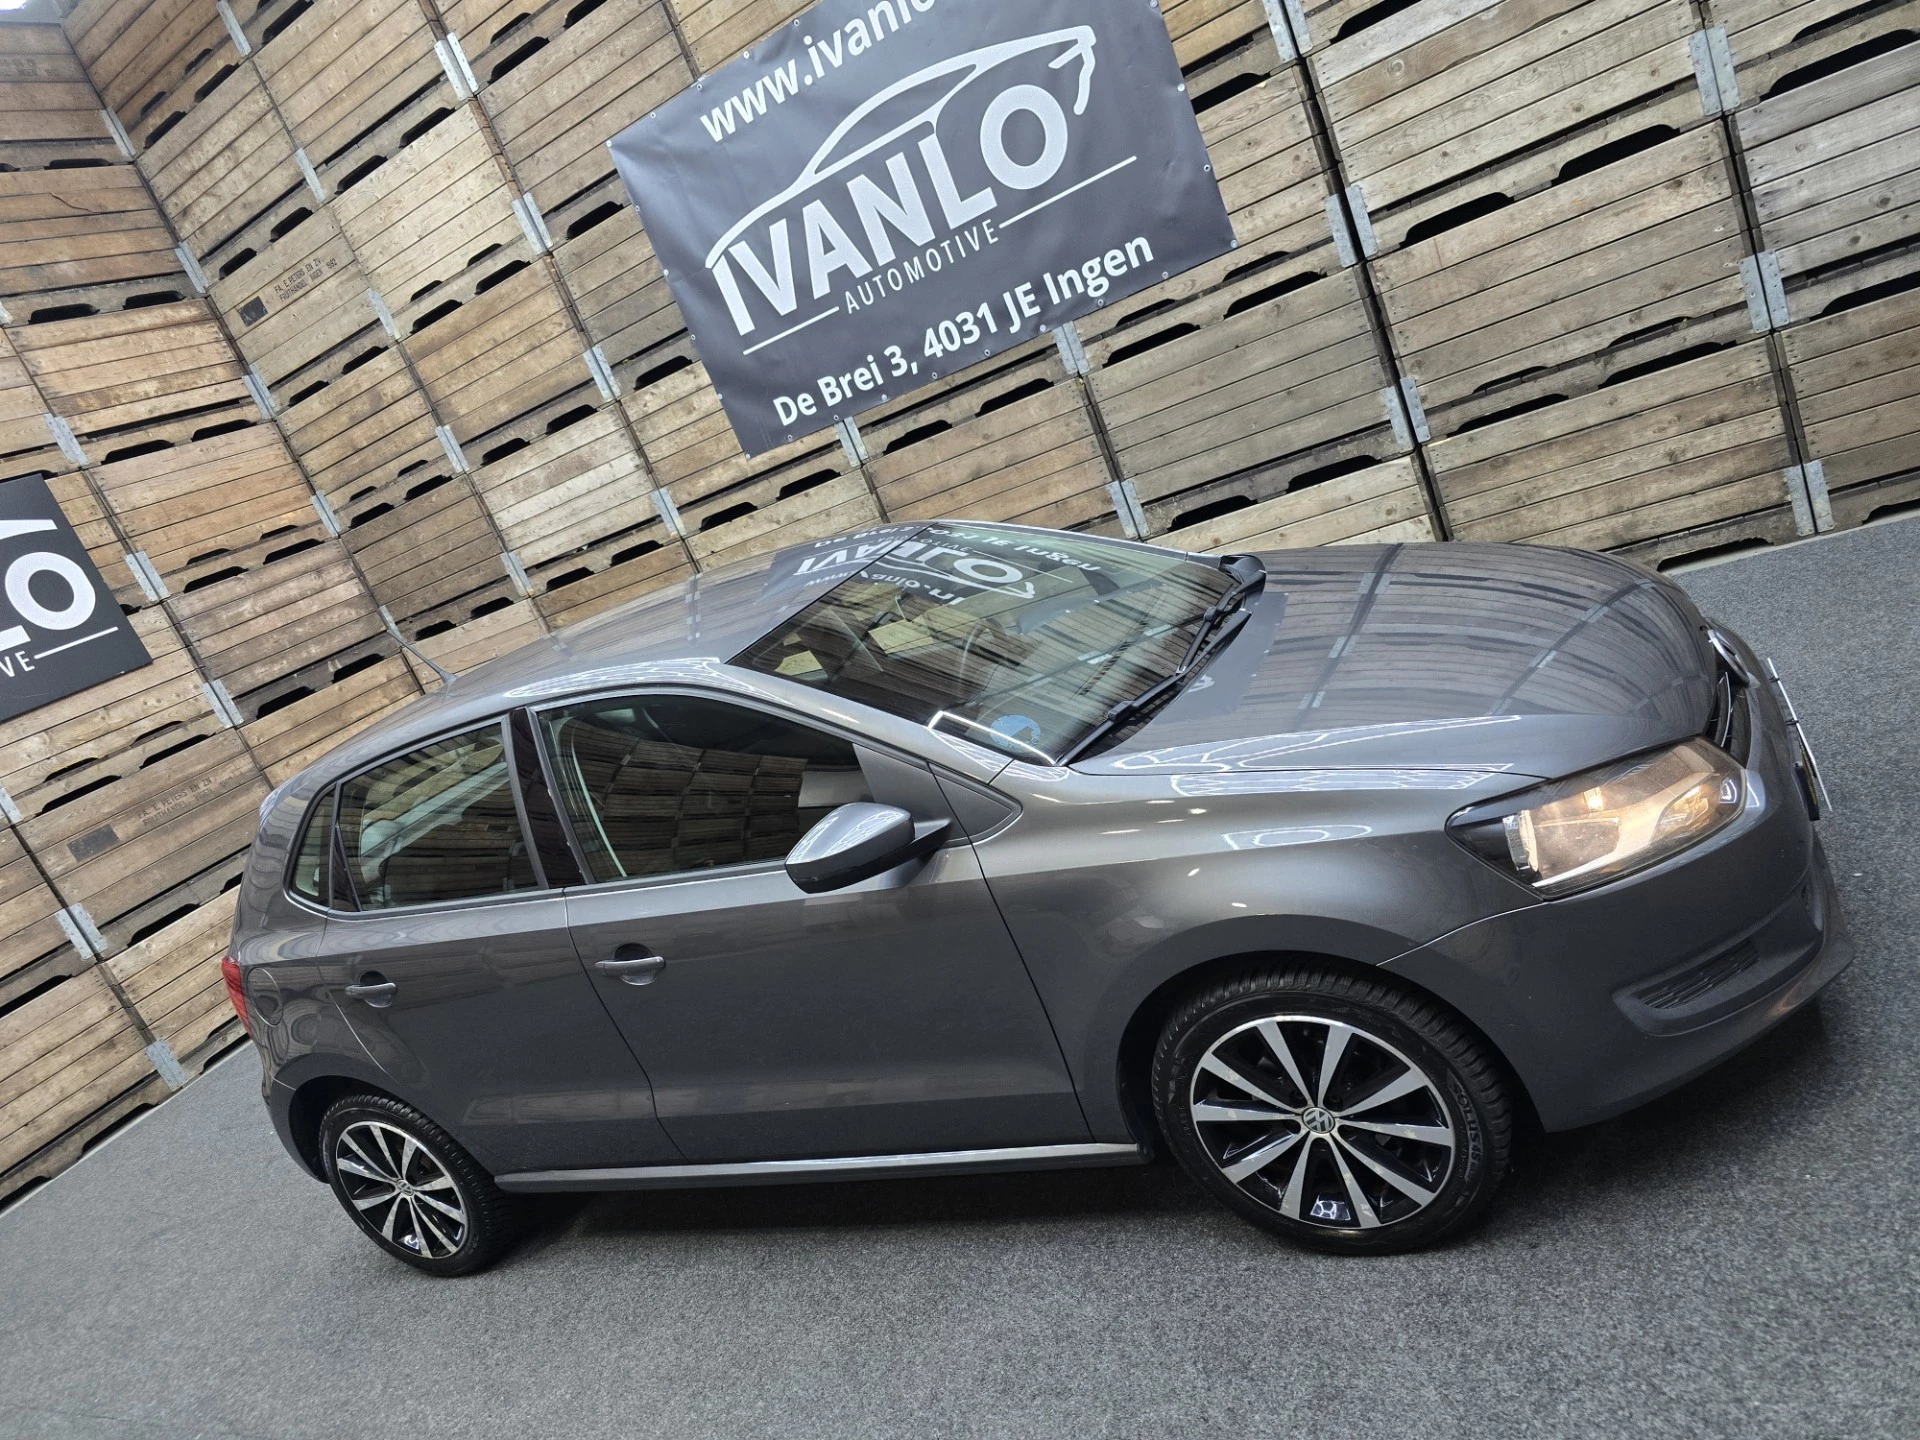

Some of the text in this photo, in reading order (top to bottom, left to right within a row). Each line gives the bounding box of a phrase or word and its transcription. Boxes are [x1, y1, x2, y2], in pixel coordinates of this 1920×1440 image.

[712, 84, 1068, 336] IVANLO
[844, 219, 999, 314] AUTOMOTIVE
[773, 236, 1154, 426] De Brei 3, 4031 JE Ingen
